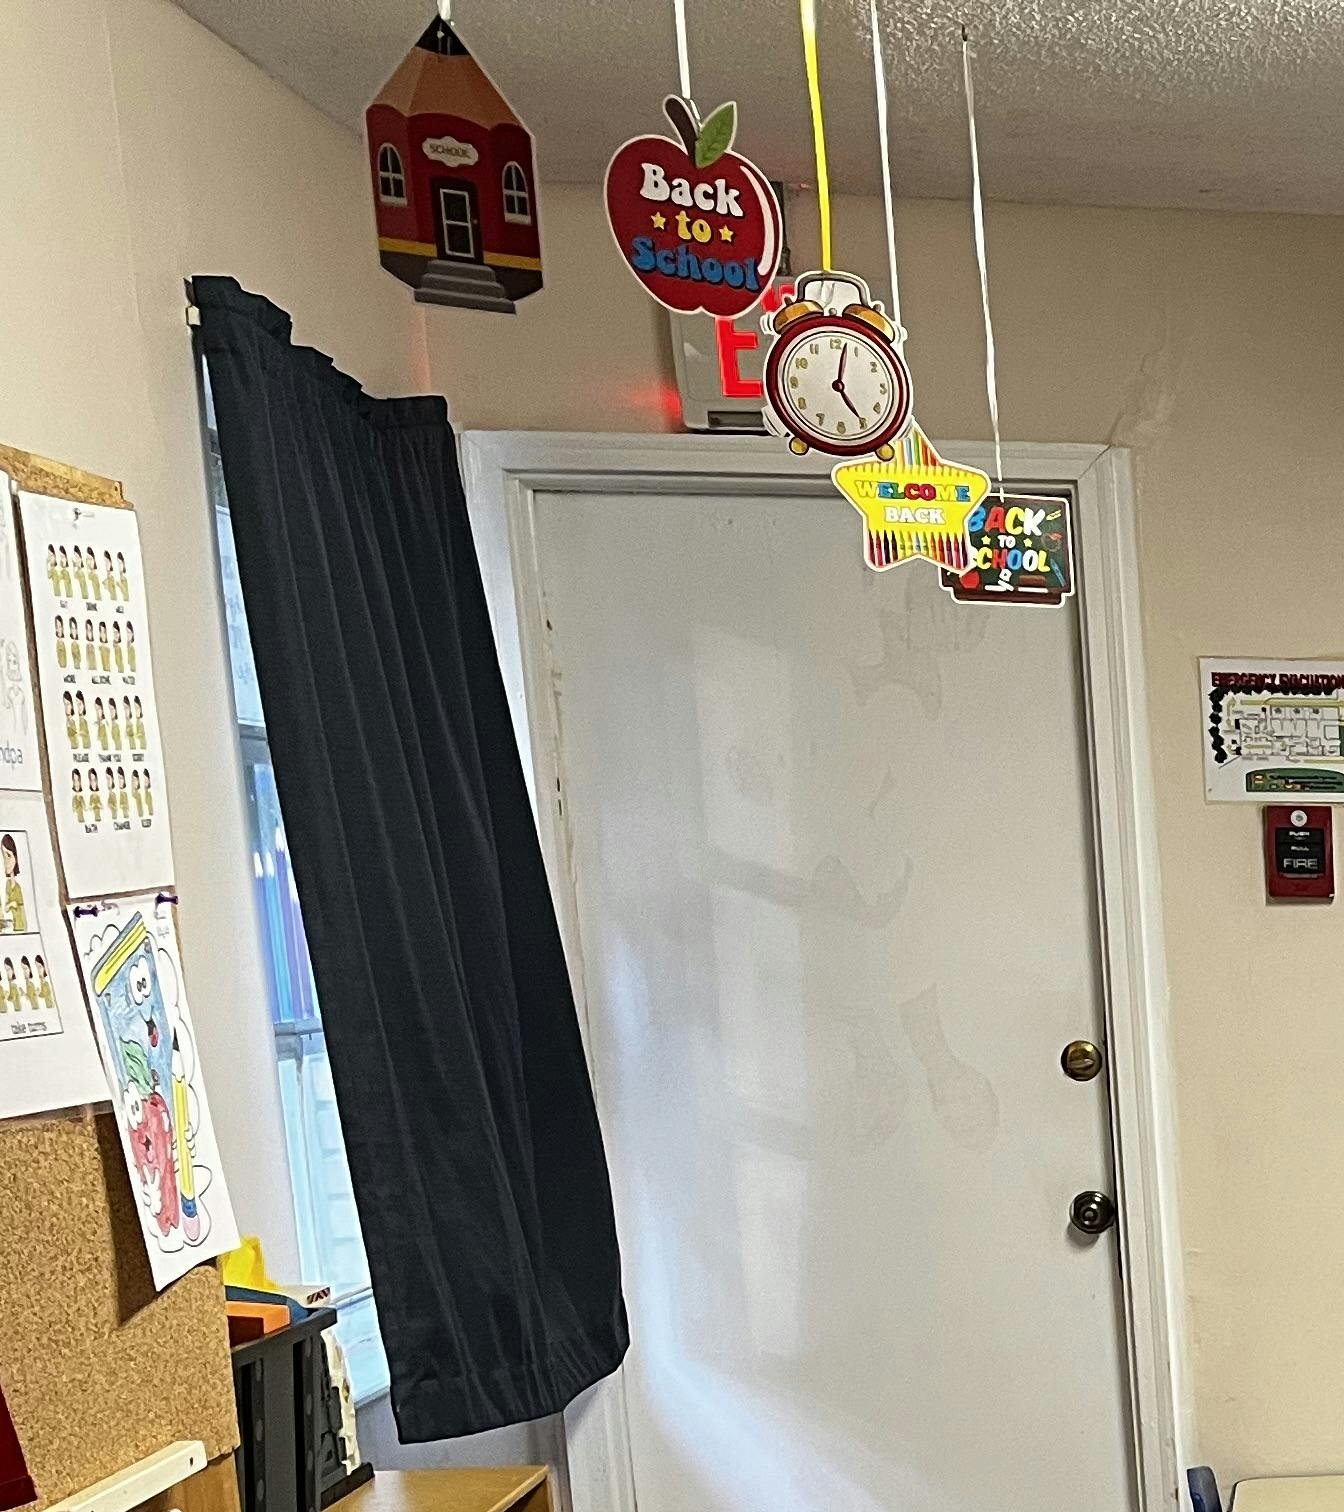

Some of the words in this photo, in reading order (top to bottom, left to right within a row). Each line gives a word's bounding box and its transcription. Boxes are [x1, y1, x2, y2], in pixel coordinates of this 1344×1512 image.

[640, 163, 743, 217] Back
[675, 210, 712, 243] to
[632, 236, 760, 291] School
[855, 480, 971, 502] WELCOME
[884, 506, 946, 524] BACK
[967, 505, 1046, 537] BACK
[997, 535, 1016, 549] TO
[1283, 858, 1318, 869] FIRE
